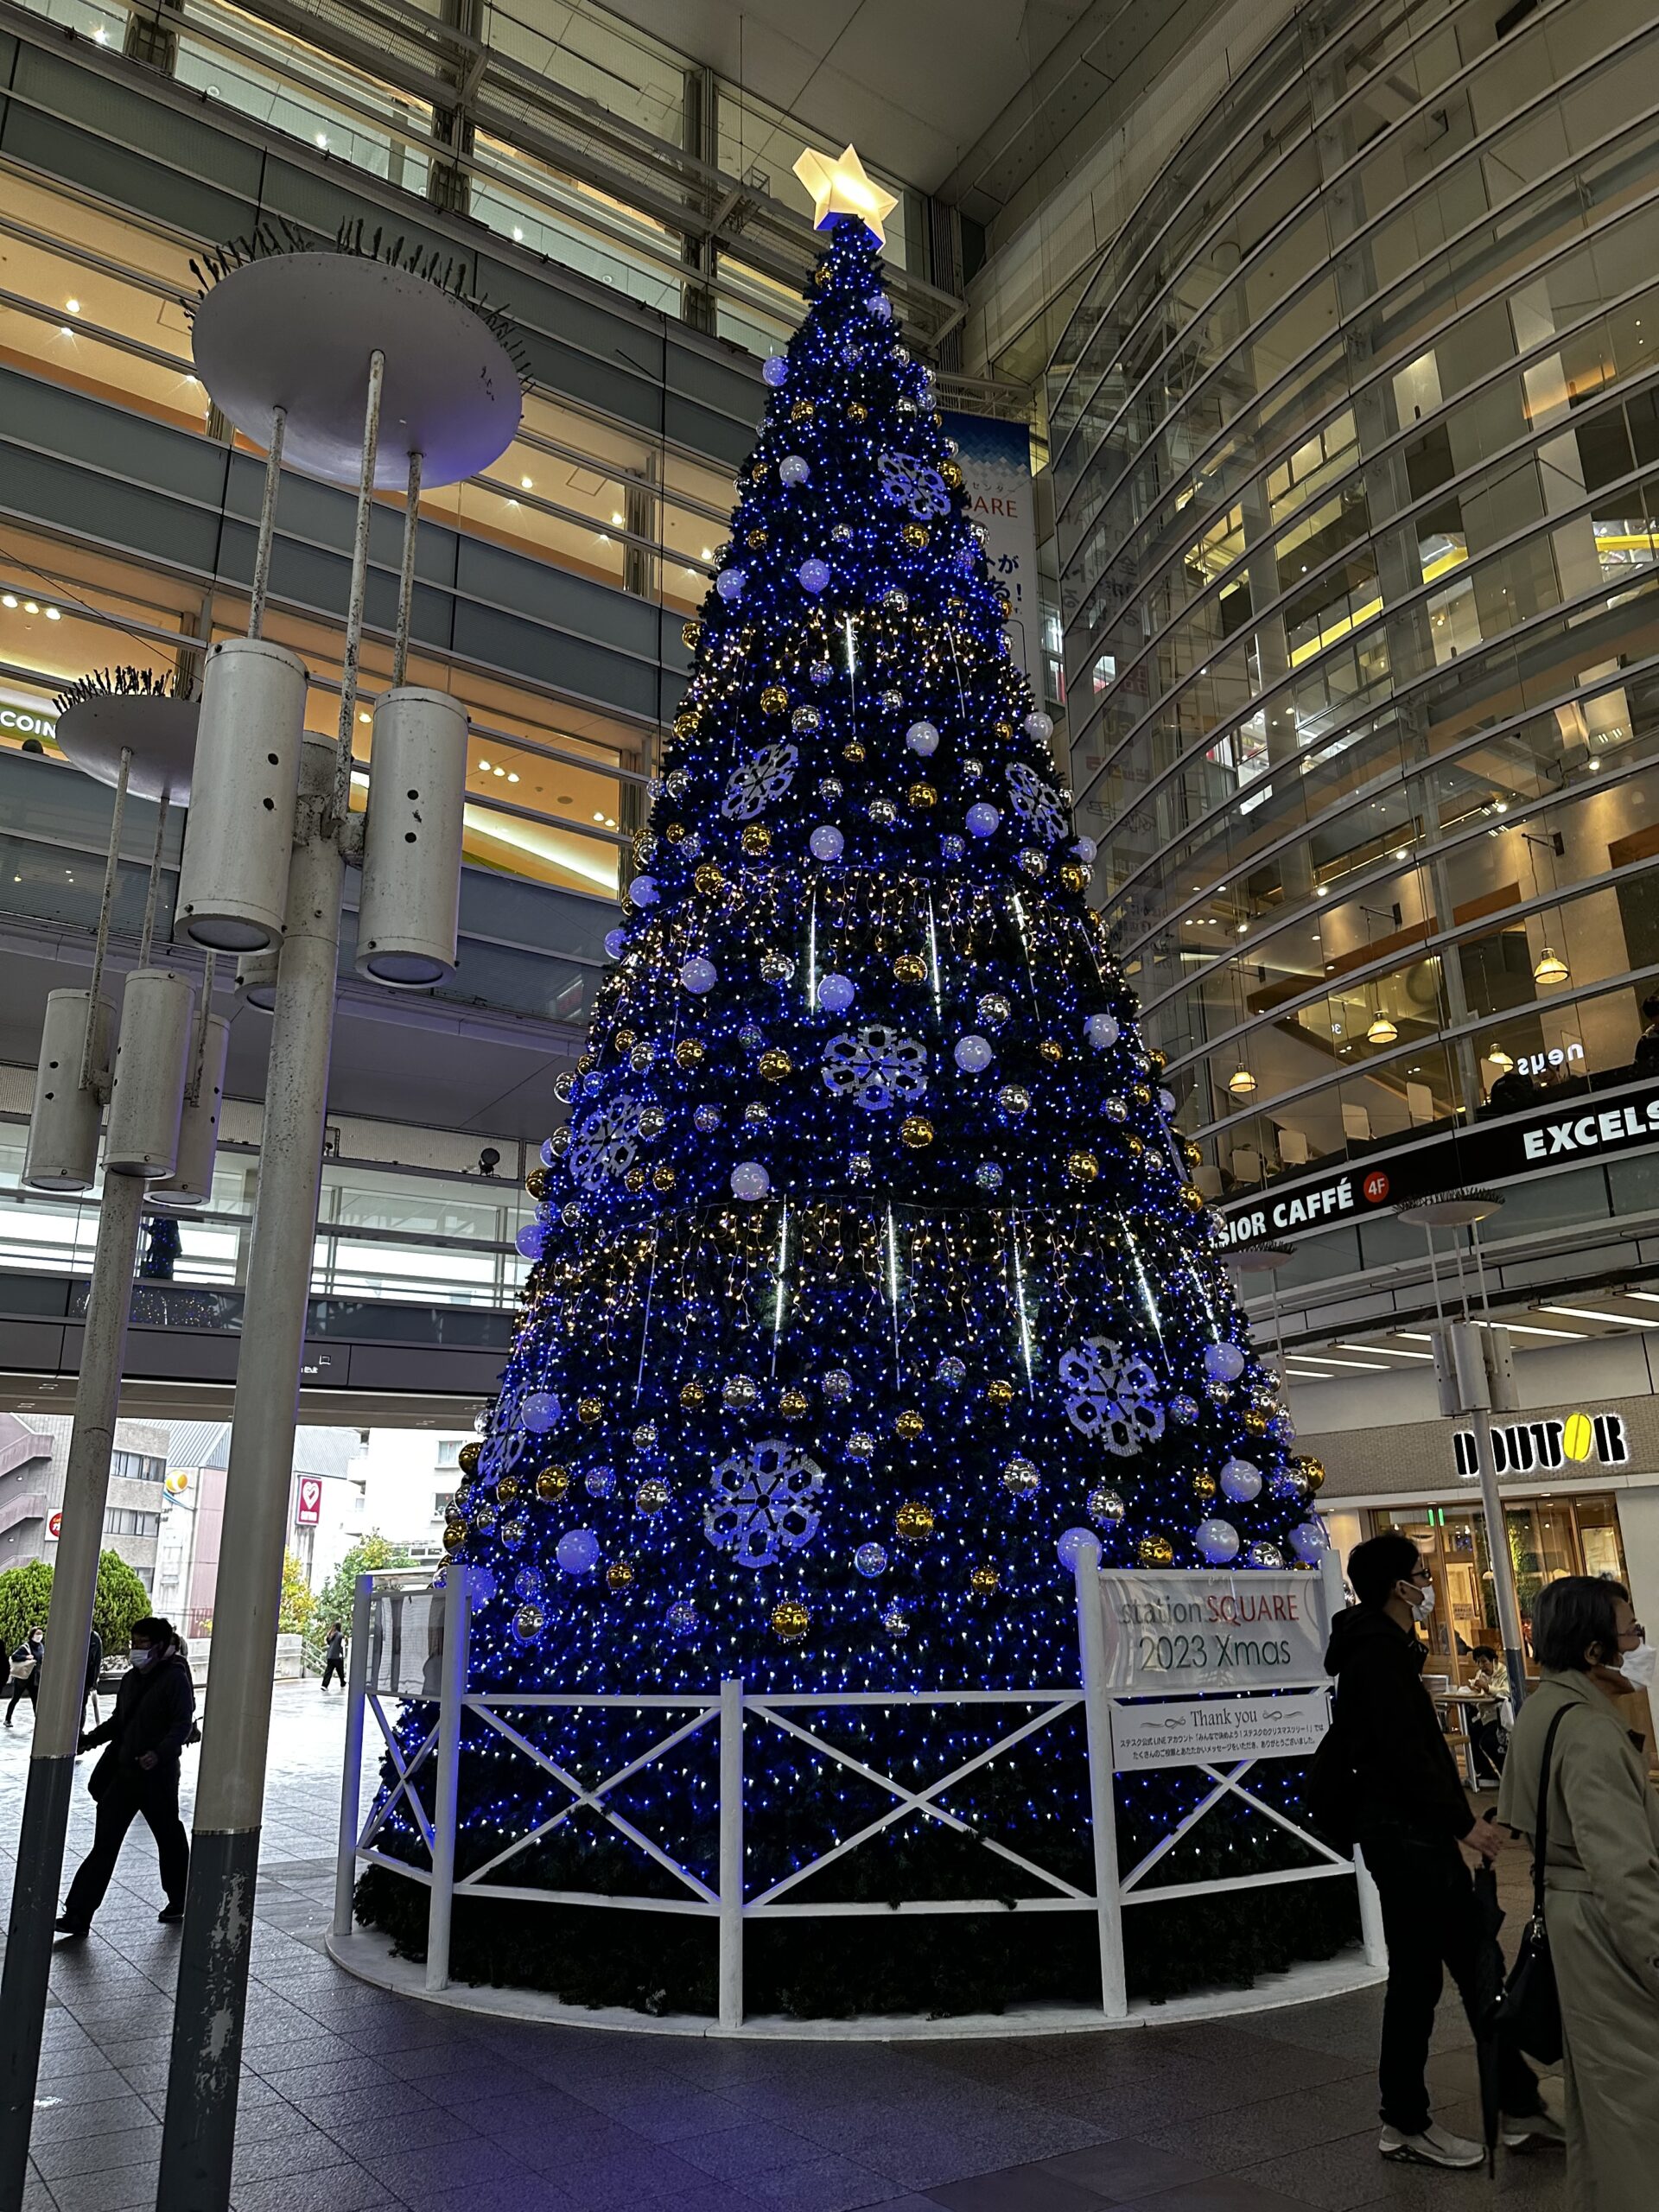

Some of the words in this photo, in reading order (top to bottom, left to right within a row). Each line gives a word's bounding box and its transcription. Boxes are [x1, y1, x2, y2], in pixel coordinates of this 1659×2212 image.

[0, 710, 56, 740] COIN
[1211, 1211, 1267, 1249] SIOR
[1273, 1177, 1354, 1228] CAFFÉ
[1368, 1178, 1386, 1196] 4F
[1122, 1595, 1202, 1624] station
[1207, 1594, 1300, 1626] SQUARE
[1139, 1635, 1208, 1671] 2023
[1215, 1634, 1291, 1668] Xmas
[1191, 1707, 1232, 1727] Thank
[1235, 1710, 1257, 1729] you
